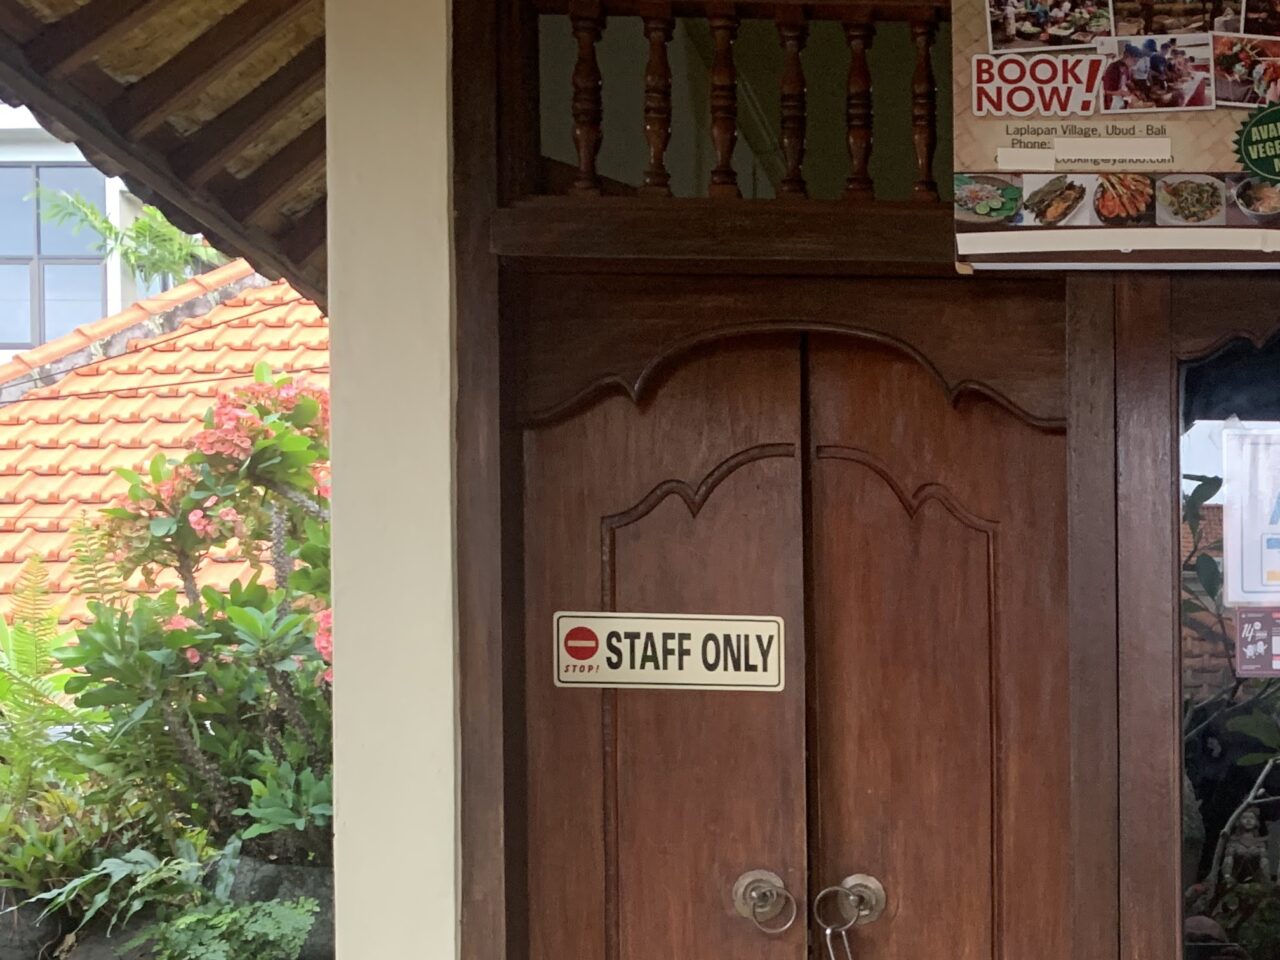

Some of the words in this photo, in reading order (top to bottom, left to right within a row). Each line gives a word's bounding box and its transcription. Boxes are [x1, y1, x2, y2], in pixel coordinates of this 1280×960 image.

[1005, 124, 1057, 137] Laplapan
[1061, 124, 1101, 138] Village,
[1106, 124, 1136, 136] Ubud
[1146, 124, 1167, 136] Bali
[1011, 139, 1052, 149] Phone:
[605, 631, 692, 671] STAFF
[701, 632, 775, 673] ONLY
[563, 664, 600, 674] STOP!
